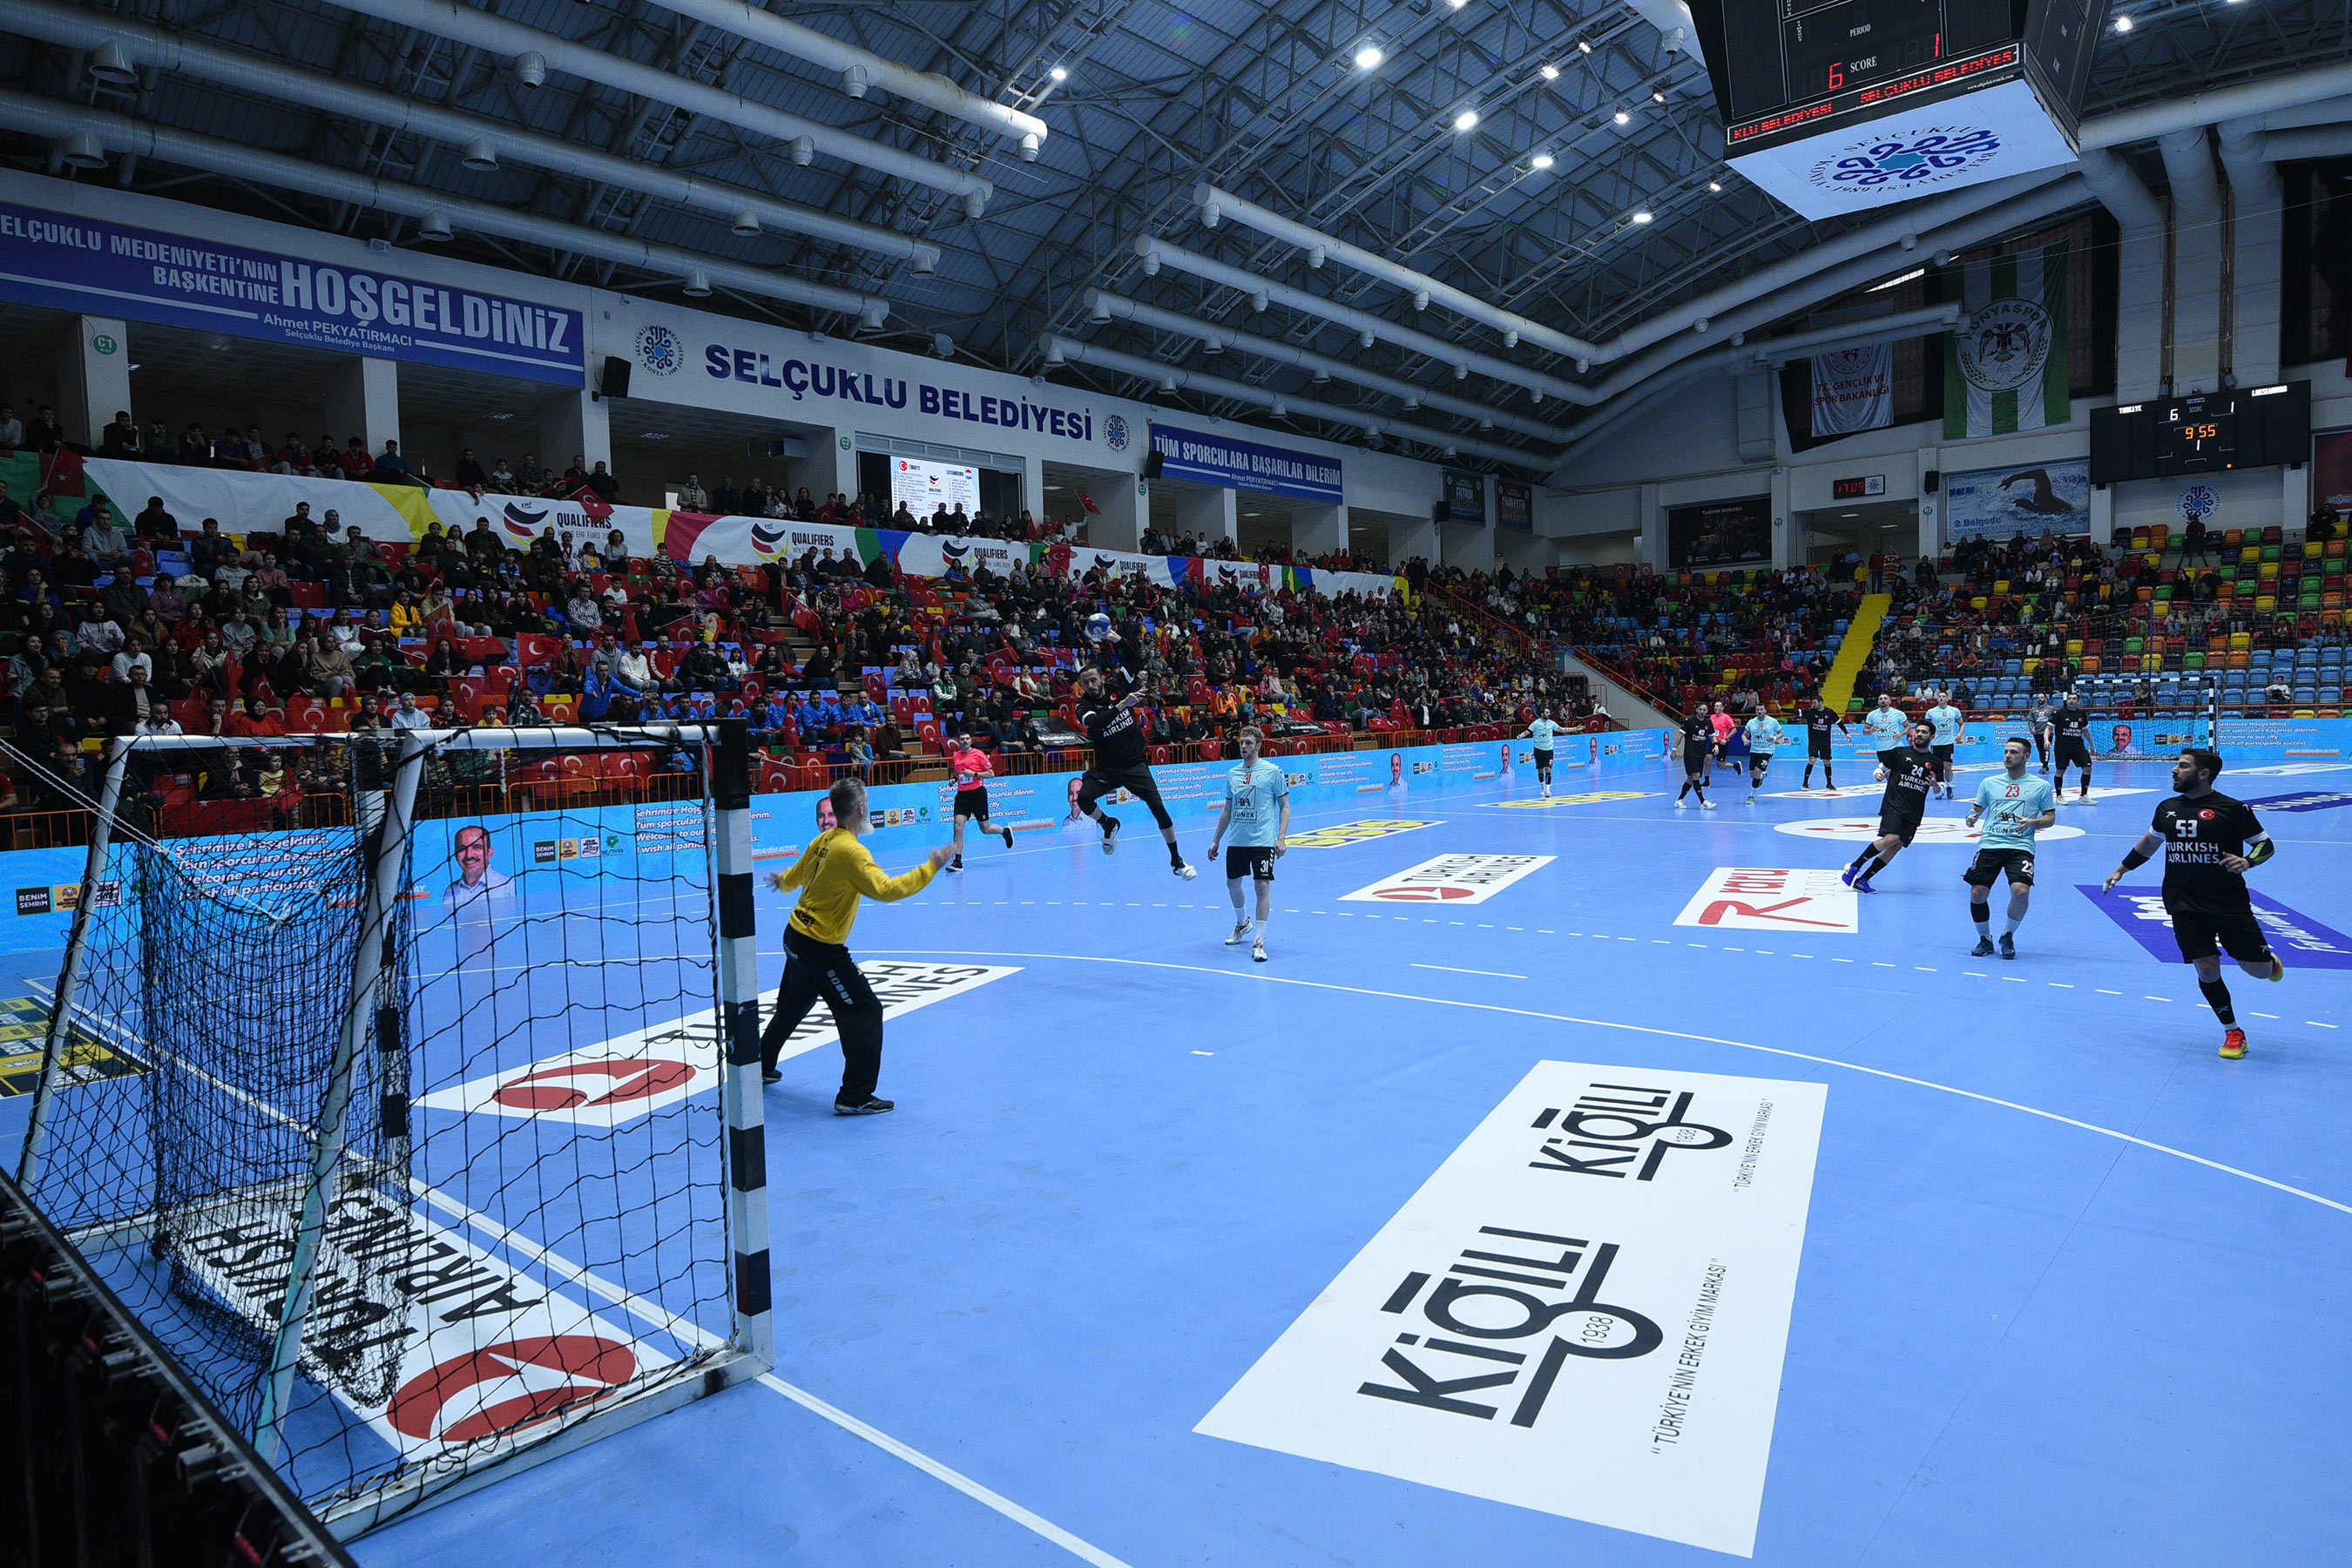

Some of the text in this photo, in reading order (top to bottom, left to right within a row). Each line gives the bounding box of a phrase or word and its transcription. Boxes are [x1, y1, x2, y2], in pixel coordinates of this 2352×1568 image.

[1849, 24, 1871, 37] PERIOD
[1828, 56, 1877, 90] 6 SCORE
[0, 214, 102, 251] ELÇUKLU
[1968, 304, 2046, 338] ONYASPOR
[263, 313, 412, 347] Ahmet PEKYATIRMACI
[98, 337, 112, 348] C1
[324, 335, 361, 348] Belediye
[1875, 373, 1885, 383] VE
[706, 344, 906, 409] SELÇUKLU
[920, 384, 1092, 442] BELEDİYESİ
[1815, 386, 1889, 406] SPOR BAKANLIĞI
[2169, 409, 2179, 421] 6
[1183, 441, 1249, 471] SPORCULARA
[1252, 455, 1303, 480] BAŞARILAR
[792, 531, 835, 546] QUALIFIERS
[974, 547, 1008, 560] QUALIFIERS
[1239, 570, 1260, 579] QUALIFIER
[1103, 716, 1133, 738] AIRLINES
[1911, 765, 1923, 777] 24
[1243, 774, 1251, 784] 31
[1900, 774, 1928, 786] TURKIS
[2005, 786, 2020, 797] 23
[635, 808, 679, 820] Şehrimize
[637, 818, 702, 830] Tüm sporculara
[2175, 820, 2198, 838] 53
[637, 832, 678, 842] Welcome
[641, 842, 663, 853] wish
[665, 841, 674, 850] all
[2166, 841, 2220, 853] TURKISH
[2167, 853, 2220, 864] AIRLINES
[1260, 860, 1269, 873] 31
[1401, 855, 1492, 882] TURKISH
[1454, 856, 1538, 884] AIRLINES
[2021, 860, 2034, 874] 23
[1675, 1129, 1697, 1143] 1938
[1679, 1333, 1707, 1368] ERKEK
[1698, 1263, 1727, 1303] MARKASI
[1578, 1315, 1615, 1345] 1938
